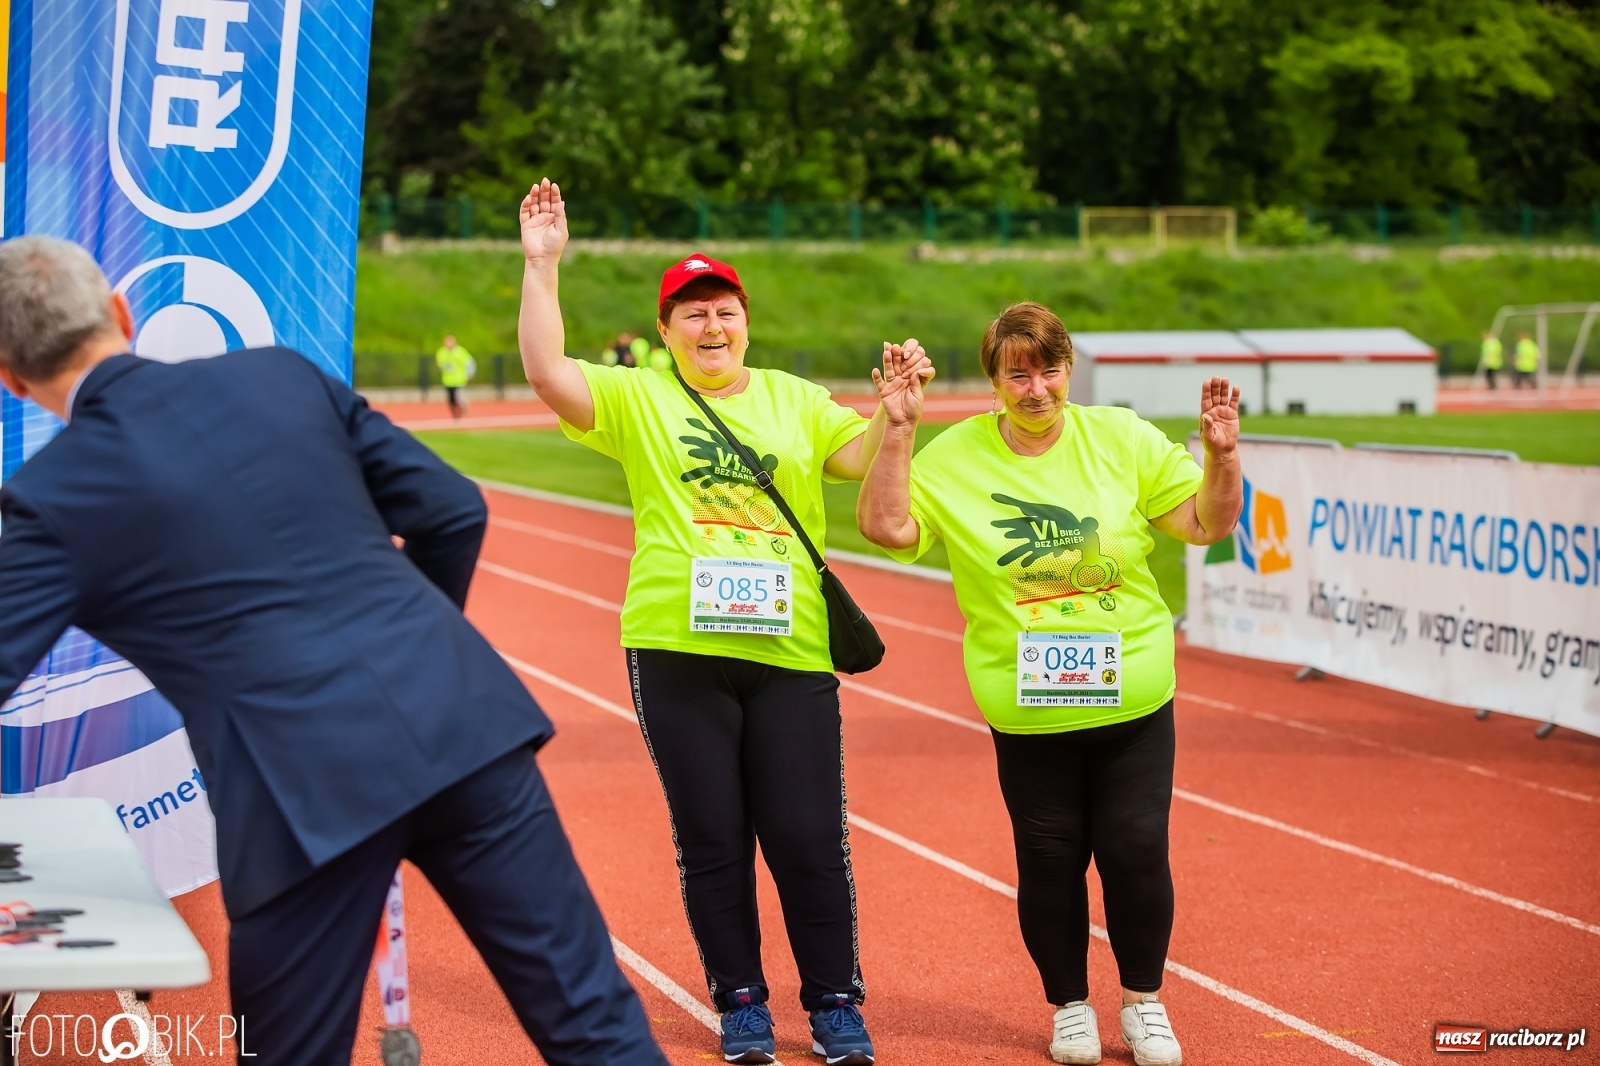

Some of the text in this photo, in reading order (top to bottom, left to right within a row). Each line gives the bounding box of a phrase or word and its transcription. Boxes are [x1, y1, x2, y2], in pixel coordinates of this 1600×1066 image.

[714, 466, 757, 482] BEZ BARIE
[1030, 519, 1081, 541] VI BIEG
[1308, 497, 1423, 562] POWIAT
[1034, 536, 1085, 549] BEZ BARIER
[718, 574, 786, 602] 085 R
[1419, 605, 1537, 671] wspieramy,
[1045, 646, 1115, 671] 084 R
